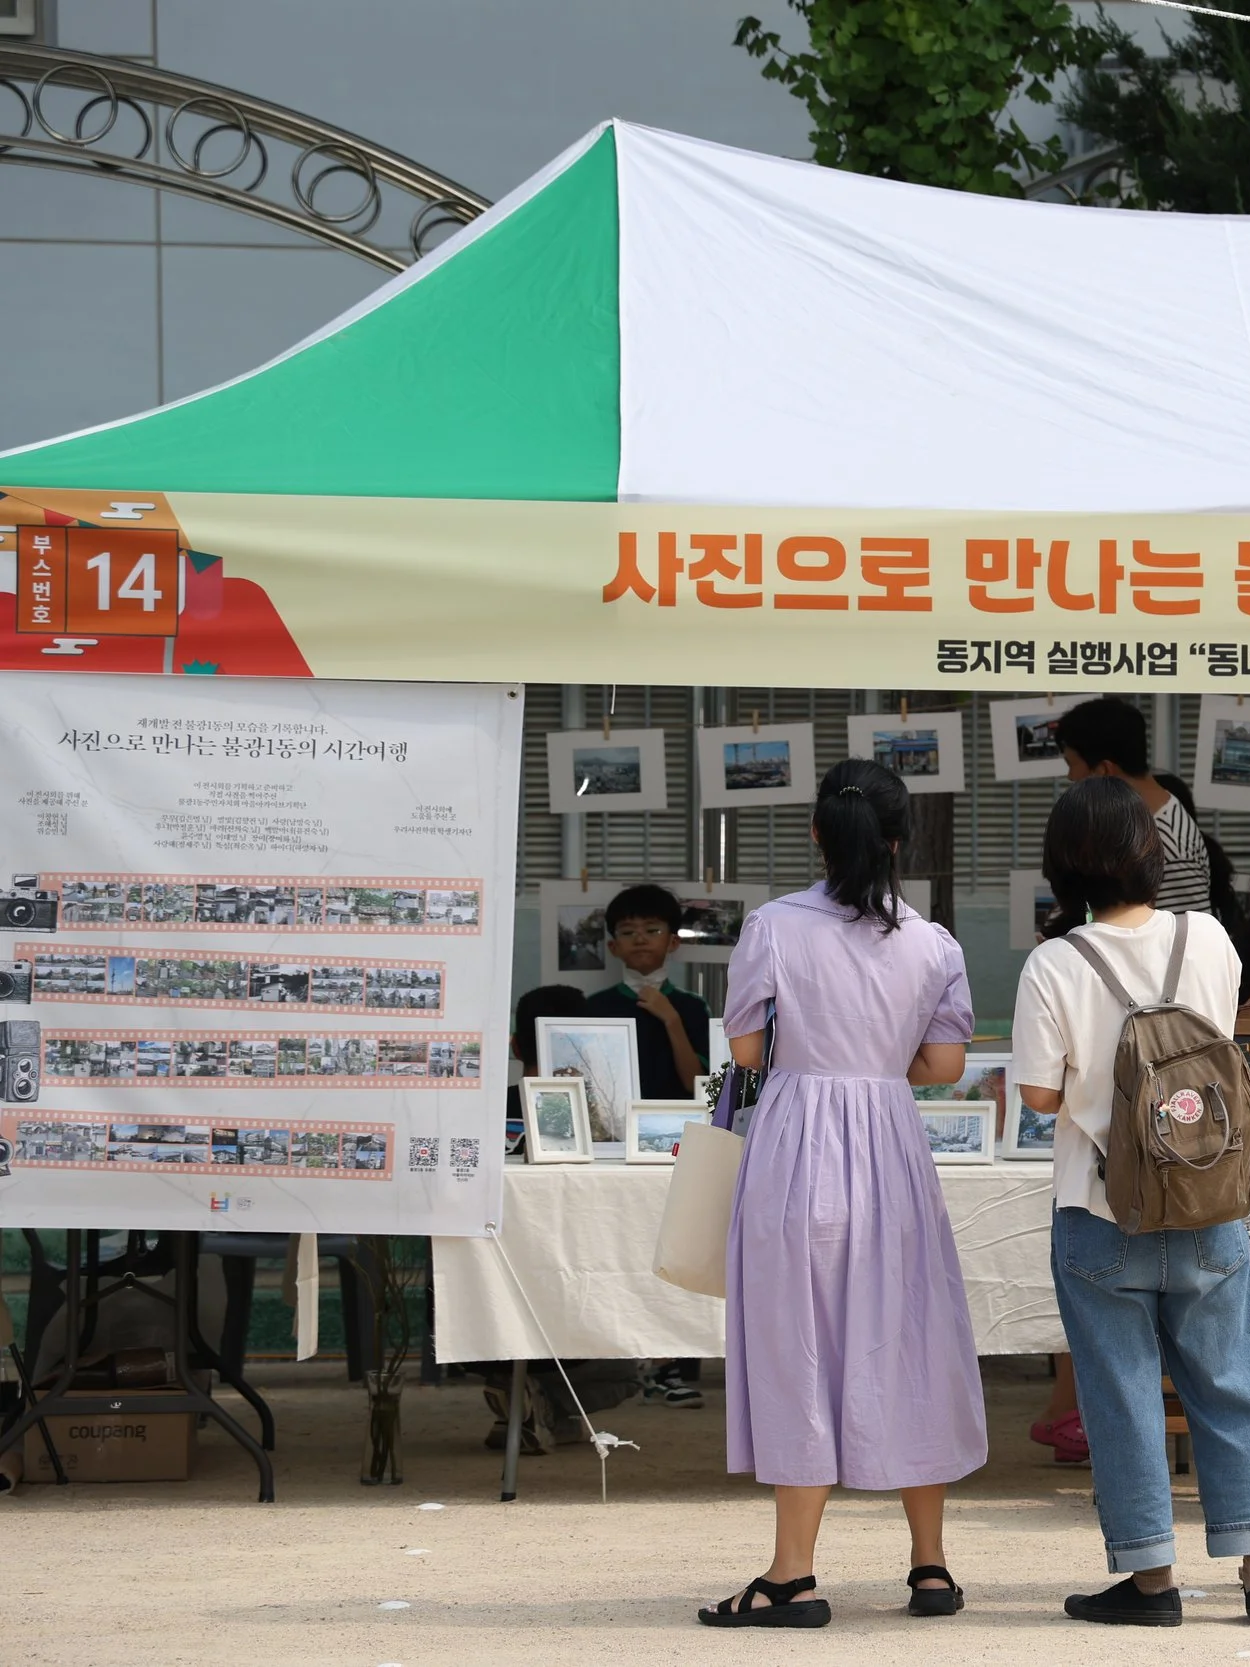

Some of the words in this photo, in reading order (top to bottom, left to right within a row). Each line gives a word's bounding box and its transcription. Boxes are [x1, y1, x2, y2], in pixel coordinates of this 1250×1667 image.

[32, 535, 52, 624] 부스번호
[87, 552, 163, 612] 14
[603, 532, 932, 611] 사진으로
[966, 539, 1204, 615] 만나는
[936, 639, 1035, 675] 동지역
[1047, 641, 1178, 676] 실행사업
[137, 718, 170, 730] 재개발
[172, 719, 183, 731] 전
[185, 720, 233, 732] 불광1동의
[236, 721, 269, 734] 모습을
[271, 723, 329, 735] 기록합니다.
[58, 729, 147, 752] 사진으로
[152, 733, 217, 756] 만나는
[222, 736, 316, 760] 불광1동의
[323, 739, 408, 763] 시간여행
[69, 1424, 147, 1442] coupang
